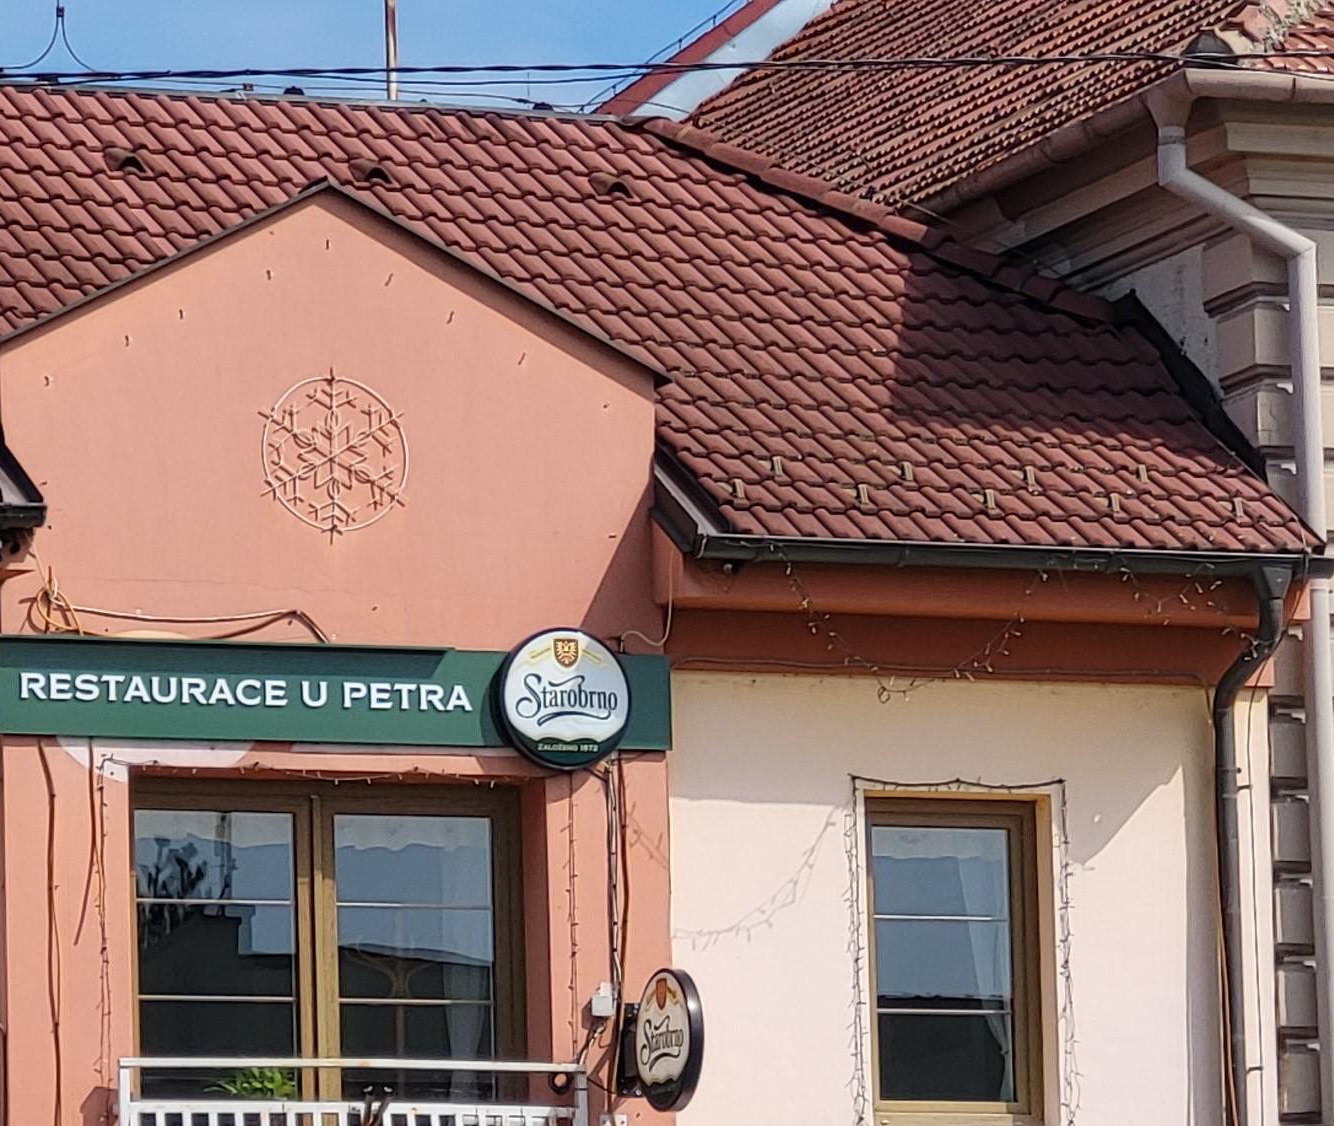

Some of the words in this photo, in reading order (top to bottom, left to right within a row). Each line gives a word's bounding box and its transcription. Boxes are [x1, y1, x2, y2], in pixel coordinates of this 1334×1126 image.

[20, 671, 288, 708] RESTAURACE
[301, 680, 329, 709] U
[342, 682, 473, 713] PETRA
[515, 672, 619, 721] Starobrno
